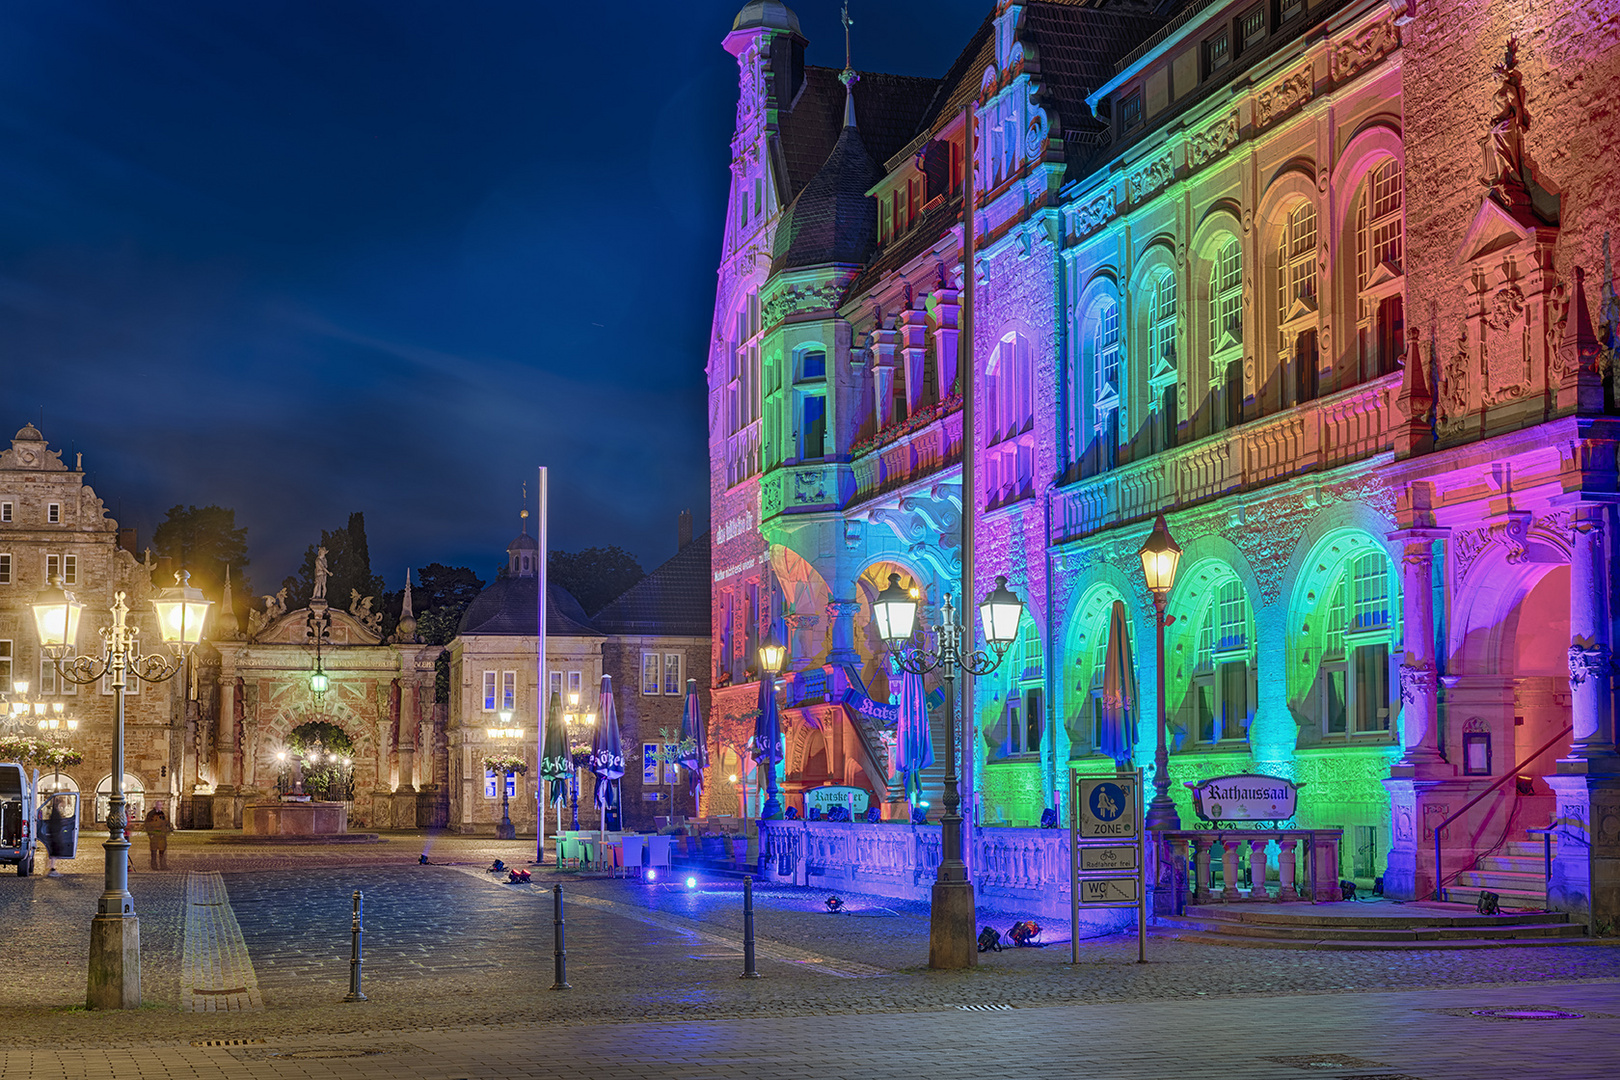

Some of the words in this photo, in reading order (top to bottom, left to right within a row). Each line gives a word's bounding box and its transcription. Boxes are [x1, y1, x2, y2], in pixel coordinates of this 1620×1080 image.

[814, 791, 863, 802] Ratskeer
[1207, 784, 1289, 802] Rathaussaal
[1093, 823, 1122, 834] ZONE
[1119, 860, 1131, 868] frei
[1088, 881, 1107, 894] WC
